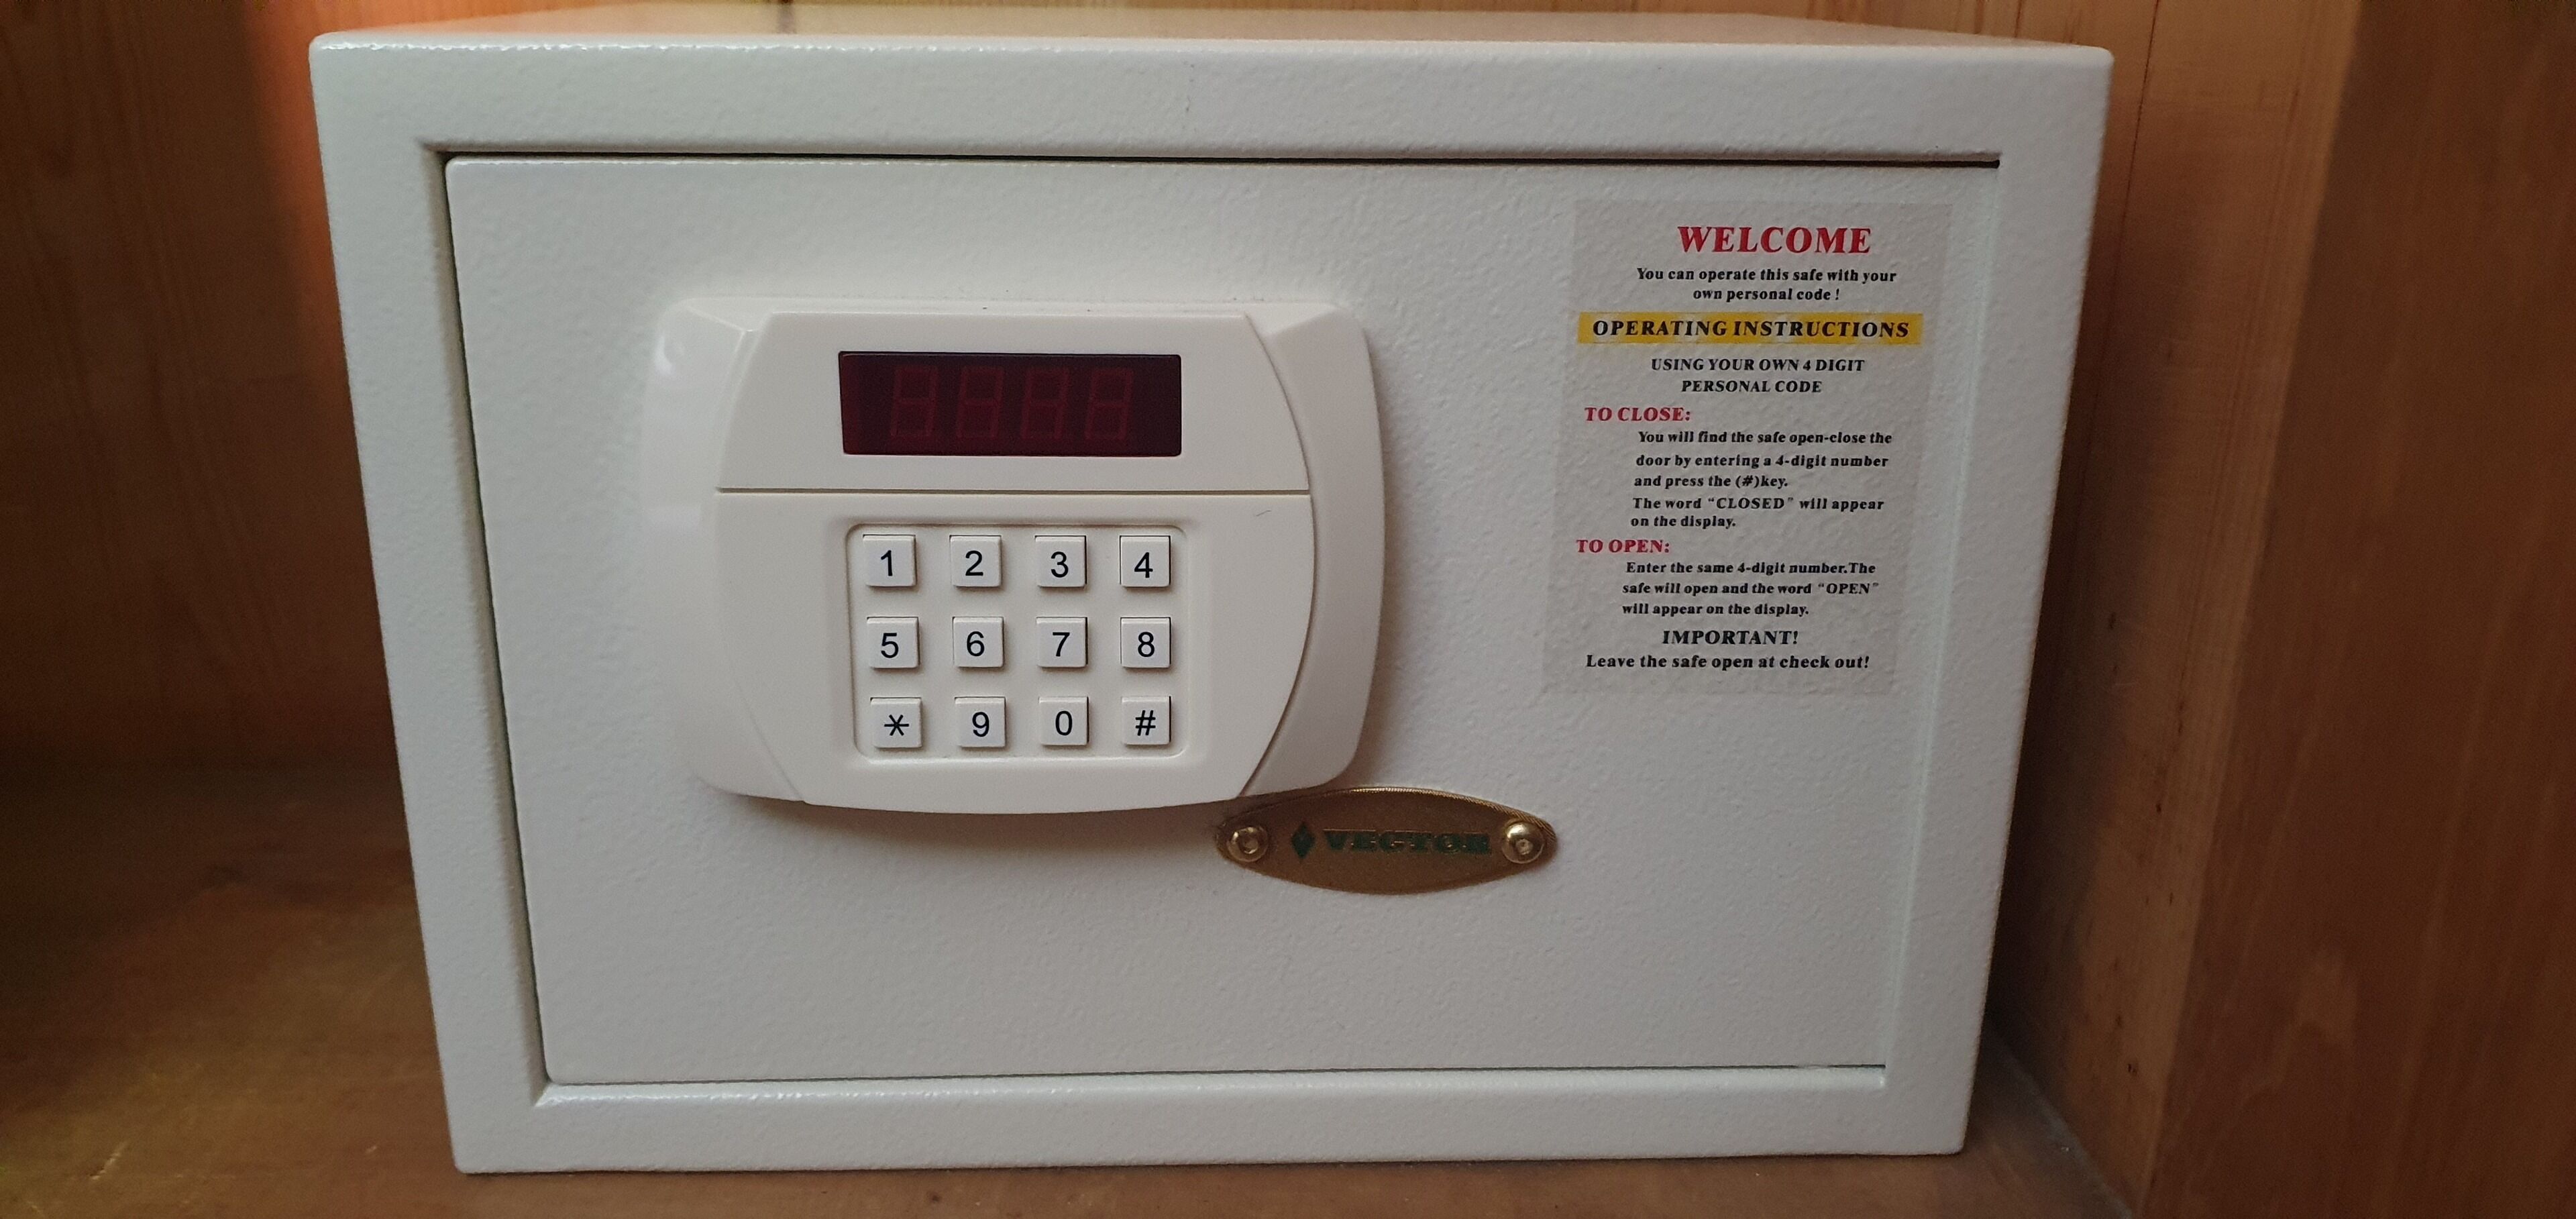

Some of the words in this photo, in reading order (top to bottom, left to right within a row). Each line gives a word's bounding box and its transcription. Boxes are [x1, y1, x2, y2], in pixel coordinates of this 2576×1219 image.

[1677, 226, 1870, 254] WELCOME
[1637, 268, 1664, 280] You
[1668, 270, 1694, 280] can
[1699, 269, 1756, 282] operate
[1760, 268, 1789, 280] this
[1792, 269, 1823, 281] safe
[1827, 269, 1858, 281] with
[1862, 272, 1896, 284] your
[1693, 290, 1722, 299] own
[1726, 288, 1792, 303] personal
[1796, 288, 1831, 300] code
[1593, 320, 1727, 336] OPERATING
[1733, 321, 1909, 338] INSTRUCTIONS
[1652, 358, 1704, 370] USING
[1709, 359, 1754, 370] YOUR
[1759, 359, 1799, 371] OWN
[1803, 360, 1811, 371] 4
[1815, 360, 1865, 371] DIGIT
[1681, 380, 1771, 392] PERSONAL
[1775, 380, 1822, 393] CODE
[1585, 407, 1612, 421] TO
[1617, 407, 1690, 421] CLOSE:
[1638, 431, 1664, 442] You
[1668, 431, 1694, 442] will
[1698, 431, 1727, 442] find
[1731, 431, 1754, 443] the
[1758, 431, 1786, 443] safe
[1789, 432, 1866, 445] open-close
[1870, 432, 1892, 443] the
[1636, 455, 1671, 466] door
[1675, 455, 1691, 468] by
[1695, 454, 1760, 469] entering
[1775, 455, 1826, 469] 4-digit
[1830, 456, 1888, 467] number
[1634, 475, 1662, 486] and
[1665, 478, 1703, 489] press
[1709, 475, 1731, 486] the
[1633, 498, 1661, 509] The
[1666, 498, 1701, 509] word
[1799, 498, 1827, 509] will
[1831, 501, 1884, 512] appear
[1631, 518, 1649, 526] on
[1654, 515, 1676, 527] the
[1680, 515, 1735, 529] display.
[1576, 539, 1603, 553] TO
[1609, 539, 1669, 553] OPEN:
[881, 550, 892, 576] 1
[965, 551, 983, 576] 2
[1051, 551, 1068, 578] 3
[1134, 552, 1153, 578] 4
[1626, 562, 1666, 573] Enter
[1670, 562, 1693, 573] the
[1697, 565, 1733, 573] same
[1737, 562, 1785, 576] 4-digit
[1623, 582, 1651, 594] safe
[1654, 582, 1680, 594] will
[1684, 585, 1718, 596] open
[1721, 583, 1748, 594] and
[1752, 583, 1774, 594] the
[1778, 583, 1811, 594] word
[1622, 603, 1649, 614] will
[1652, 606, 1703, 617] appear
[1707, 606, 1723, 614] on
[1728, 603, 1751, 615] the
[1754, 603, 1809, 617] display.
[881, 633, 898, 658] 5
[967, 631, 984, 656] 6
[1053, 632, 1070, 657] 7
[1138, 632, 1155, 657] 8
[1662, 630, 1798, 645] IMPORTANT!
[1586, 655, 1635, 667] Leave
[1640, 655, 1667, 668] the
[1672, 655, 1707, 668] safe
[1712, 658, 1753, 671] open
[1758, 656, 1774, 668] at
[1780, 655, 1829, 668] check
[1835, 655, 1869, 668] out!
[973, 712, 989, 737] 9
[1055, 711, 1072, 735] 0
[1136, 710, 1156, 736] #
[1323, 829, 1492, 855] VECTOR
